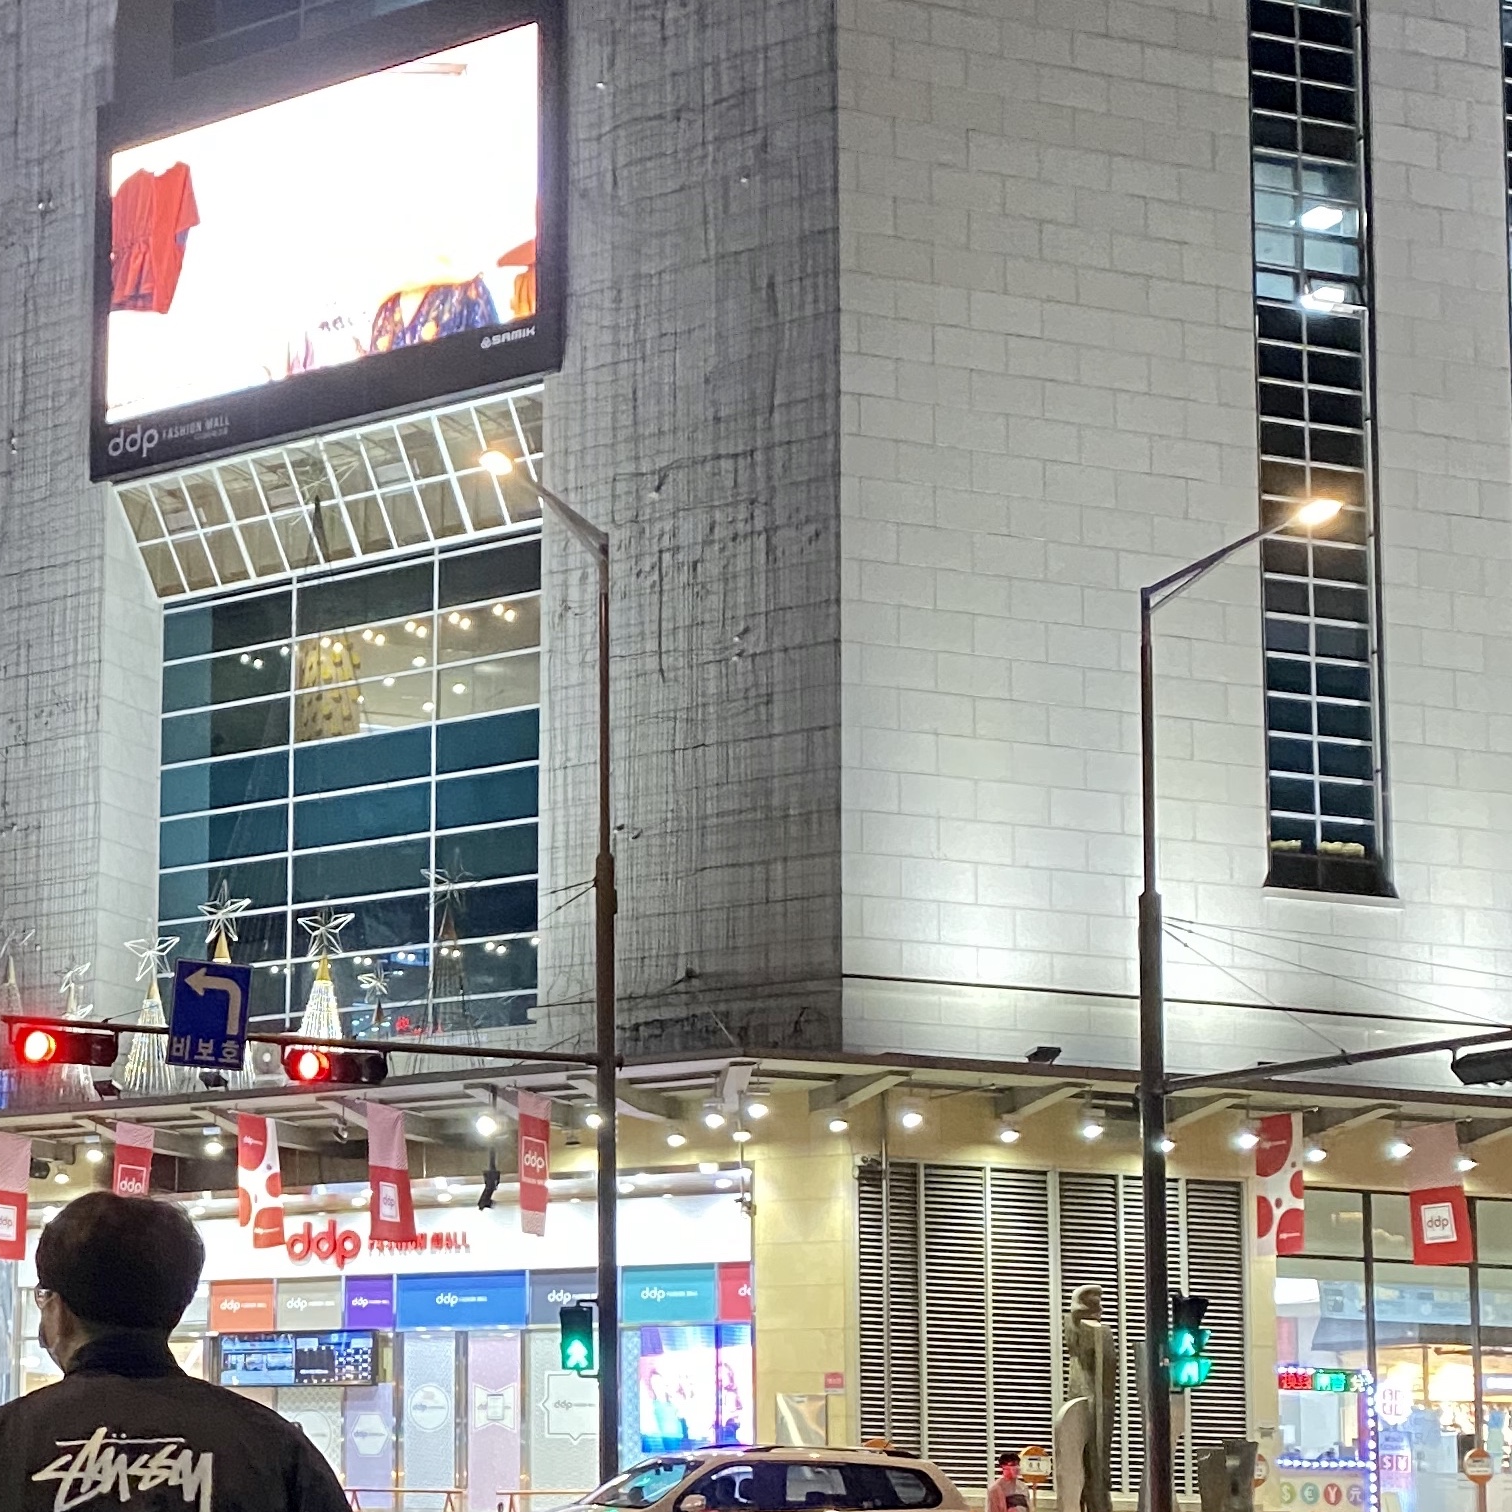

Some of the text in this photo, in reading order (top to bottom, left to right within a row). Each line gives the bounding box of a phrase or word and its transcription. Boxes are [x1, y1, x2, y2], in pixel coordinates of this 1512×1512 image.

[108, 424, 159, 458] ddp
[162, 421, 202, 440] FASHION
[170, 1034, 241, 1063] 비보호
[524, 1149, 545, 1173] ddp
[1426, 1215, 1449, 1232] ddp
[287, 1219, 362, 1271] ddp
[351, 1296, 369, 1308] ddp
[436, 1292, 459, 1307] ddp
[547, 1289, 572, 1305] ddp
[640, 1286, 666, 1302] ddp
[219, 1298, 241, 1313] ddp
[286, 1296, 308, 1311] ddp
